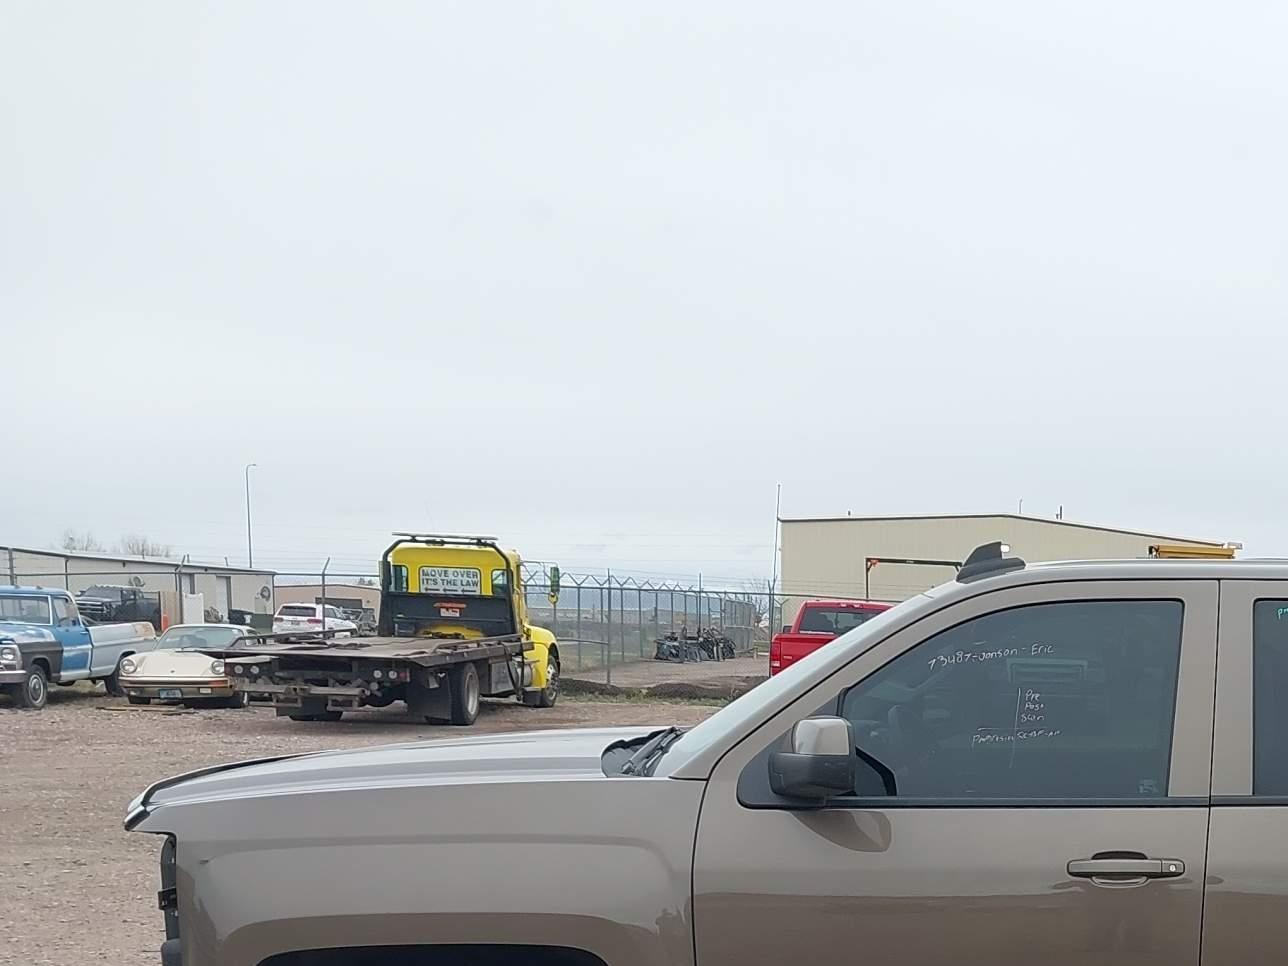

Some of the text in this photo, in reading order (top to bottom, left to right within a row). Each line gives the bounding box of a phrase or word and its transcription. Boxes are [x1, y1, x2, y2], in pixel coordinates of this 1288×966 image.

[422, 569, 478, 578] MOVE OVER
[422, 578, 438, 586] IT'S
[1031, 643, 1055, 656] Eric
